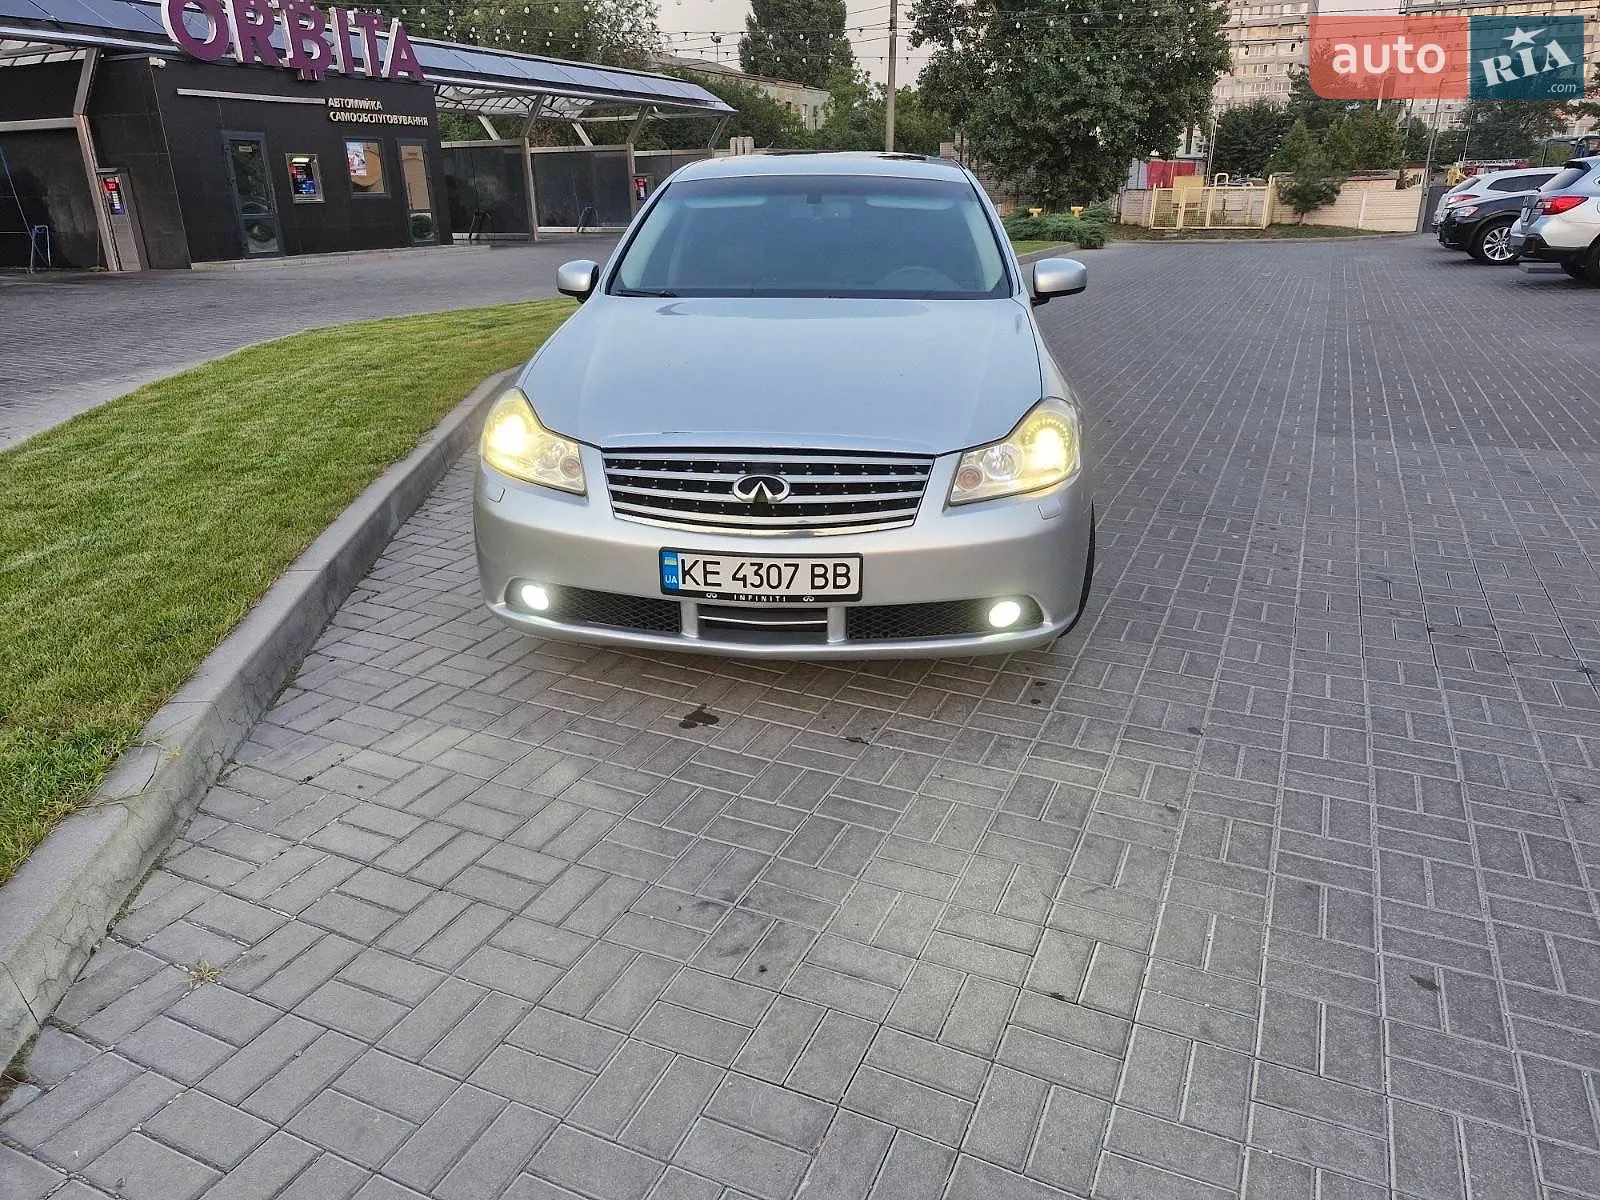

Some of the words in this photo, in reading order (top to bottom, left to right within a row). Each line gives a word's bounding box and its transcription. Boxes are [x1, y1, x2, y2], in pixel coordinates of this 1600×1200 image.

[160, 0, 425, 81] ORBITA
[328, 97, 383, 111] АВТОМИЙКА
[329, 111, 429, 126] САМООБСЛУГОВУВАННЯ
[665, 575, 678, 584] UA
[681, 558, 722, 587] KE
[731, 562, 800, 590] 4307
[810, 562, 851, 590] BB
[733, 594, 787, 602] INFINITI
